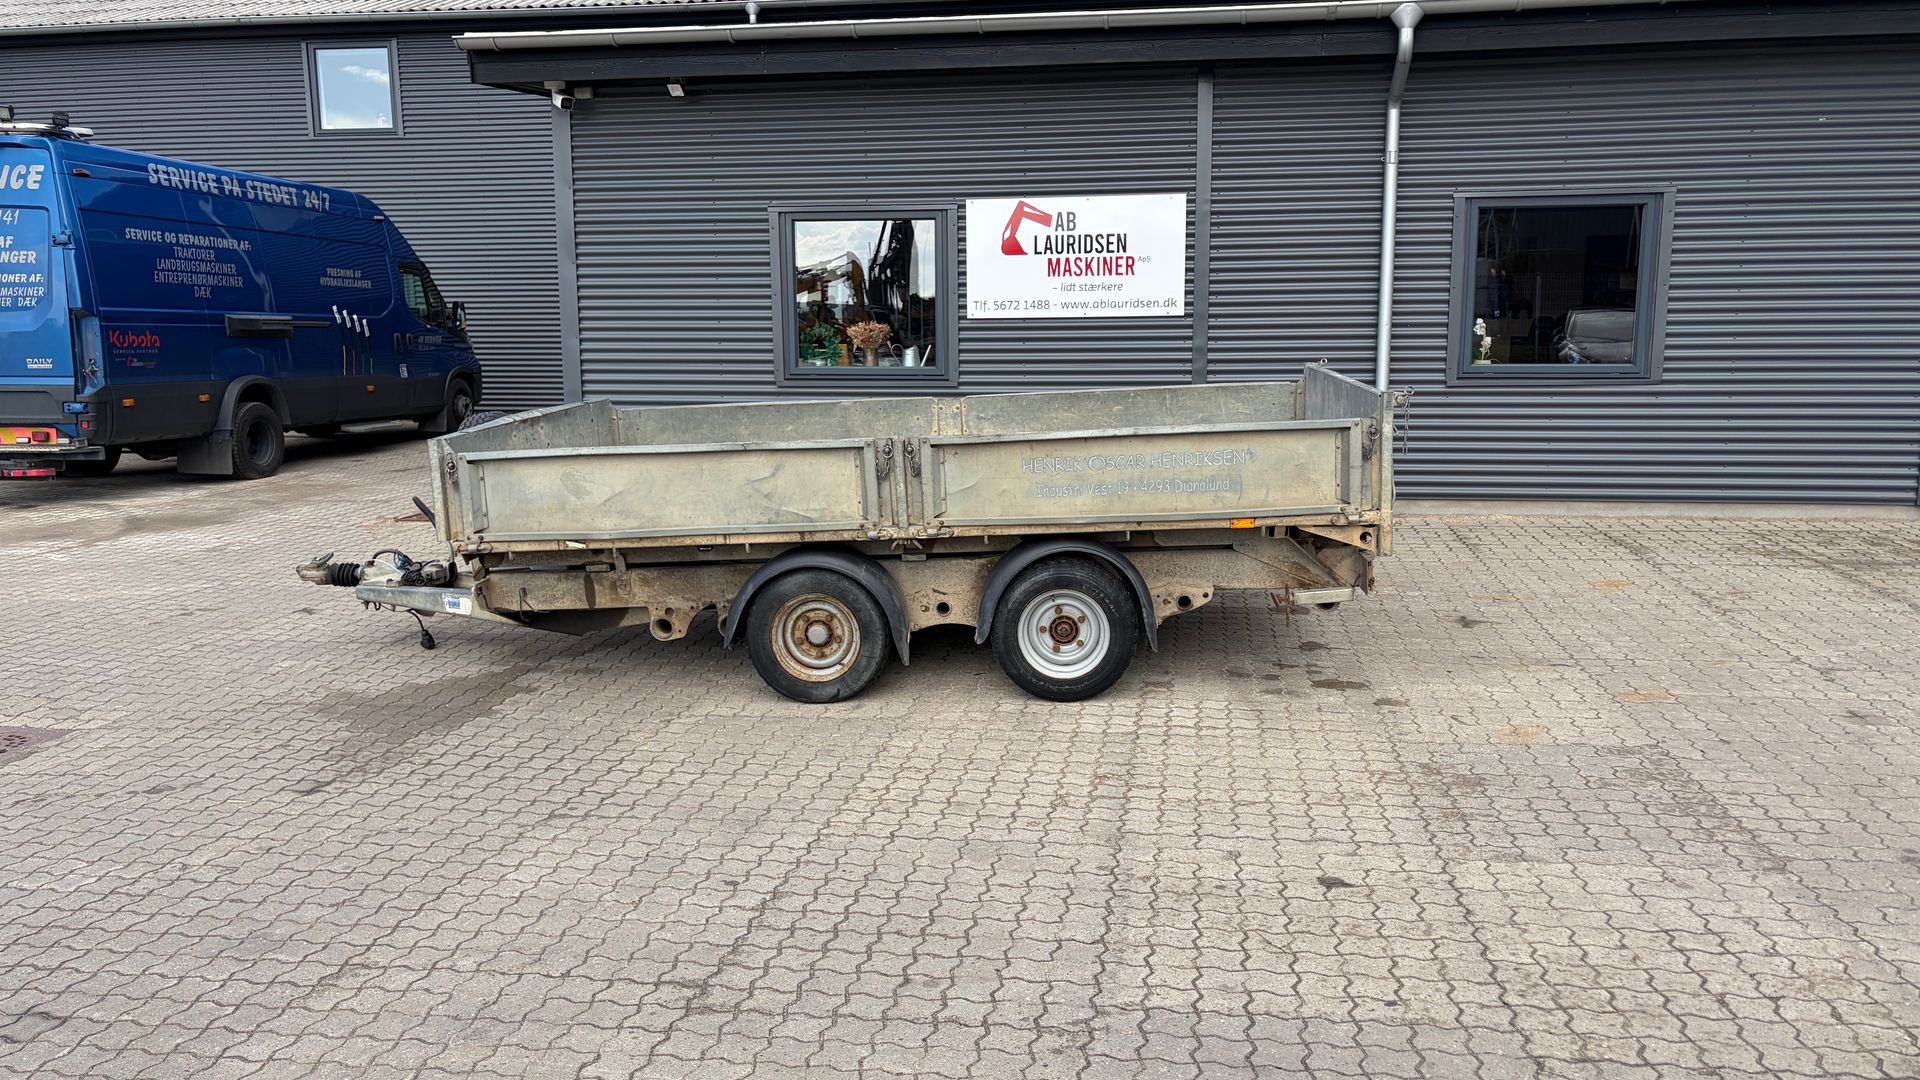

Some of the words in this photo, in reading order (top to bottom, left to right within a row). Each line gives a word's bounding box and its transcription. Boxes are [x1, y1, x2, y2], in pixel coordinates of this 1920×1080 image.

[0, 164, 45, 190] ICE
[148, 163, 219, 194] SERVICE
[221, 174, 243, 198] PÅ
[245, 180, 298, 207] STEDET
[302, 189, 330, 212] 24/7
[0, 209, 20, 225] 41
[1055, 211, 1077, 232] AB
[125, 227, 162, 243] SERVICE
[164, 232, 177, 244] OG
[178, 233, 241, 250] REPARATIONER
[239, 240, 252, 251] AF:
[1034, 233, 1127, 255] LAURIDSEN
[0, 250, 37, 264] NGER
[173, 246, 216, 261] TRAKTORER
[156, 258, 237, 275] LANDBRUGSMASKINER
[1047, 256, 1135, 277] MASKINER
[29, 273, 44, 283] AF:
[154, 270, 244, 288] ENTREPRENØRMASKINER
[194, 286, 212, 299] DÆK
[1060, 282, 1077, 292] lidt
[1079, 282, 1124, 292] stærkere
[17, 297, 38, 307] DÆK
[973, 300, 990, 312] Tlf.
[993, 300, 1020, 311] 5672
[1024, 299, 1050, 310] 1488
[1060, 297, 1178, 309] www.ablauridsen.dk
[109, 330, 160, 347] Kubota
[1022, 456, 1081, 473] HENRIK
[1087, 454, 1145, 472] OSCAR
[1151, 450, 1247, 469] HENRIKSEN
[1117, 482, 1129, 496] 19
[1140, 479, 1170, 494] 4293
